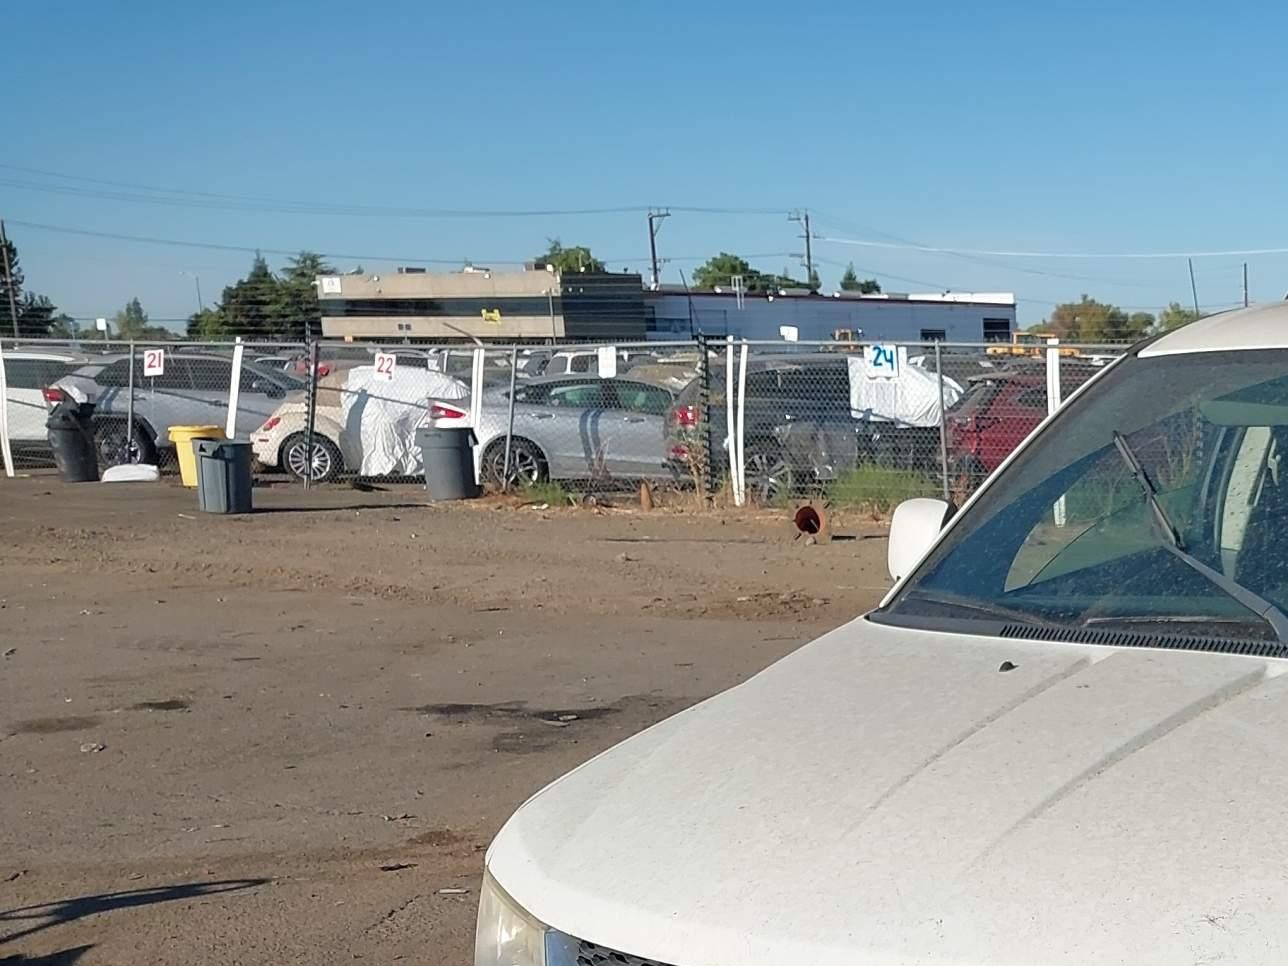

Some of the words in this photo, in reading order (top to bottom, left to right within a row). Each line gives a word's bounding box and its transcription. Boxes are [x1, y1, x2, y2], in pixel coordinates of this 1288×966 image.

[147, 351, 162, 369] 21
[376, 356, 394, 374] 22
[872, 345, 895, 371] 24
